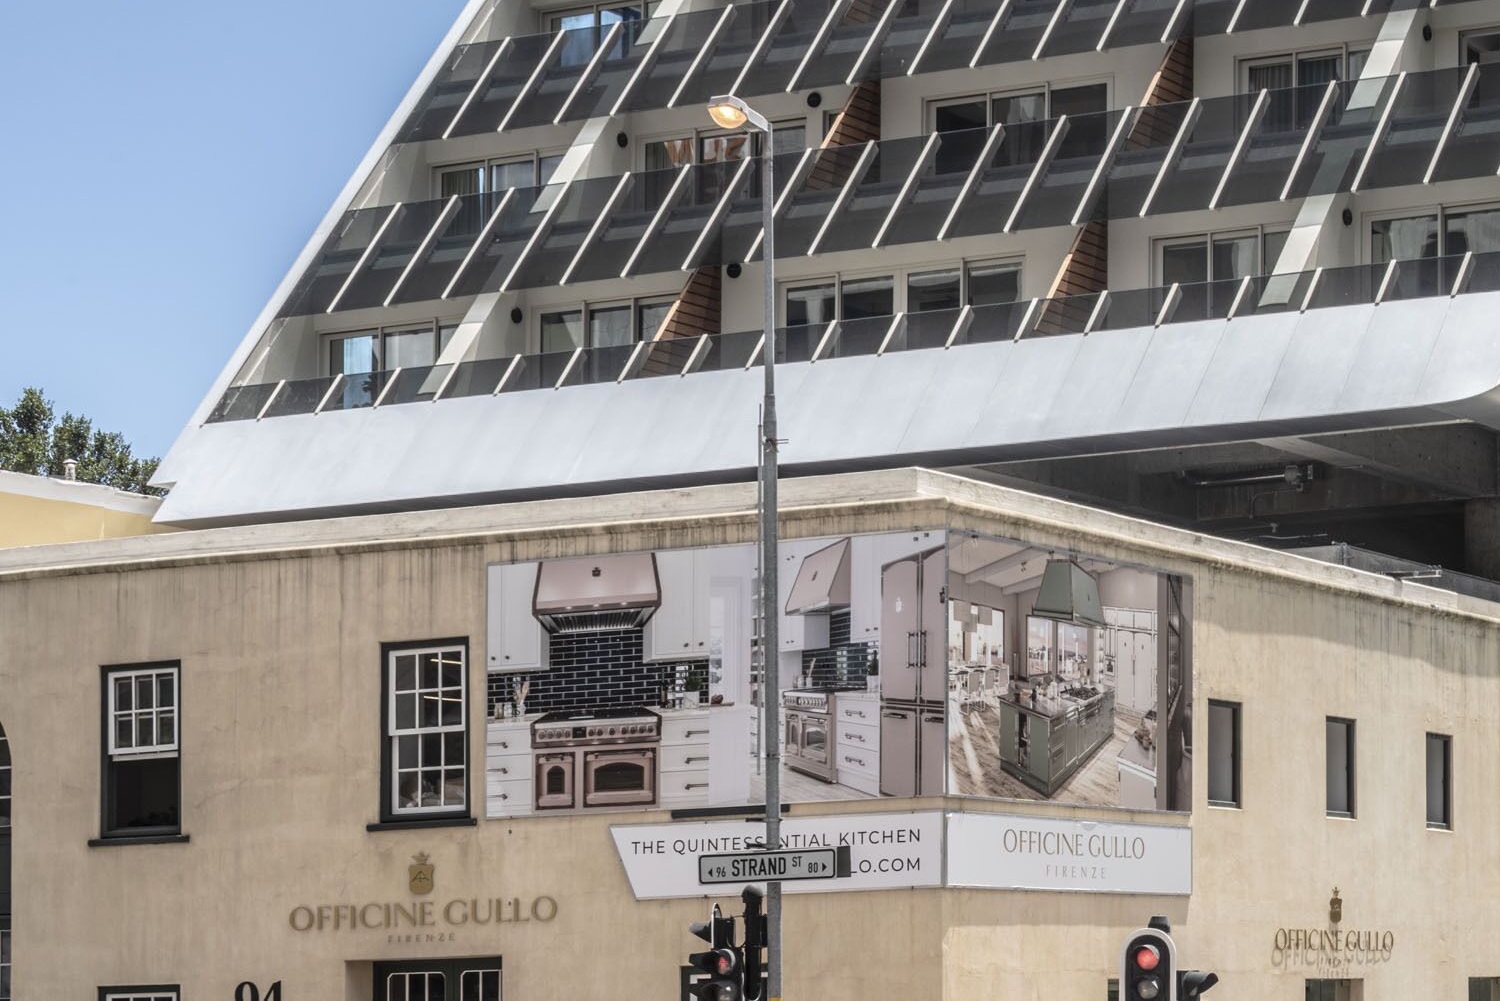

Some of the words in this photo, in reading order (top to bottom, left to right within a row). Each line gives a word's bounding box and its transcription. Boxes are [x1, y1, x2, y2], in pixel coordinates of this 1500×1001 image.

[632, 840, 666, 855] THE
[673, 832, 831, 856] QUINTESSNTIAL
[840, 828, 921, 847] KITCHEN
[1003, 828, 1084, 857] OFFICINE
[1088, 833, 1145, 859] GULLO
[716, 866, 727, 878] 96
[731, 856, 787, 877] STRAND
[792, 856, 803, 868] ST
[808, 862, 819, 873] 80
[1046, 865, 1107, 880] FIRENZE
[289, 901, 435, 931] OFFICINE
[443, 896, 558, 926] GULLO
[1275, 928, 1343, 952] OFFICINE
[1346, 929, 1394, 952] GULLO
